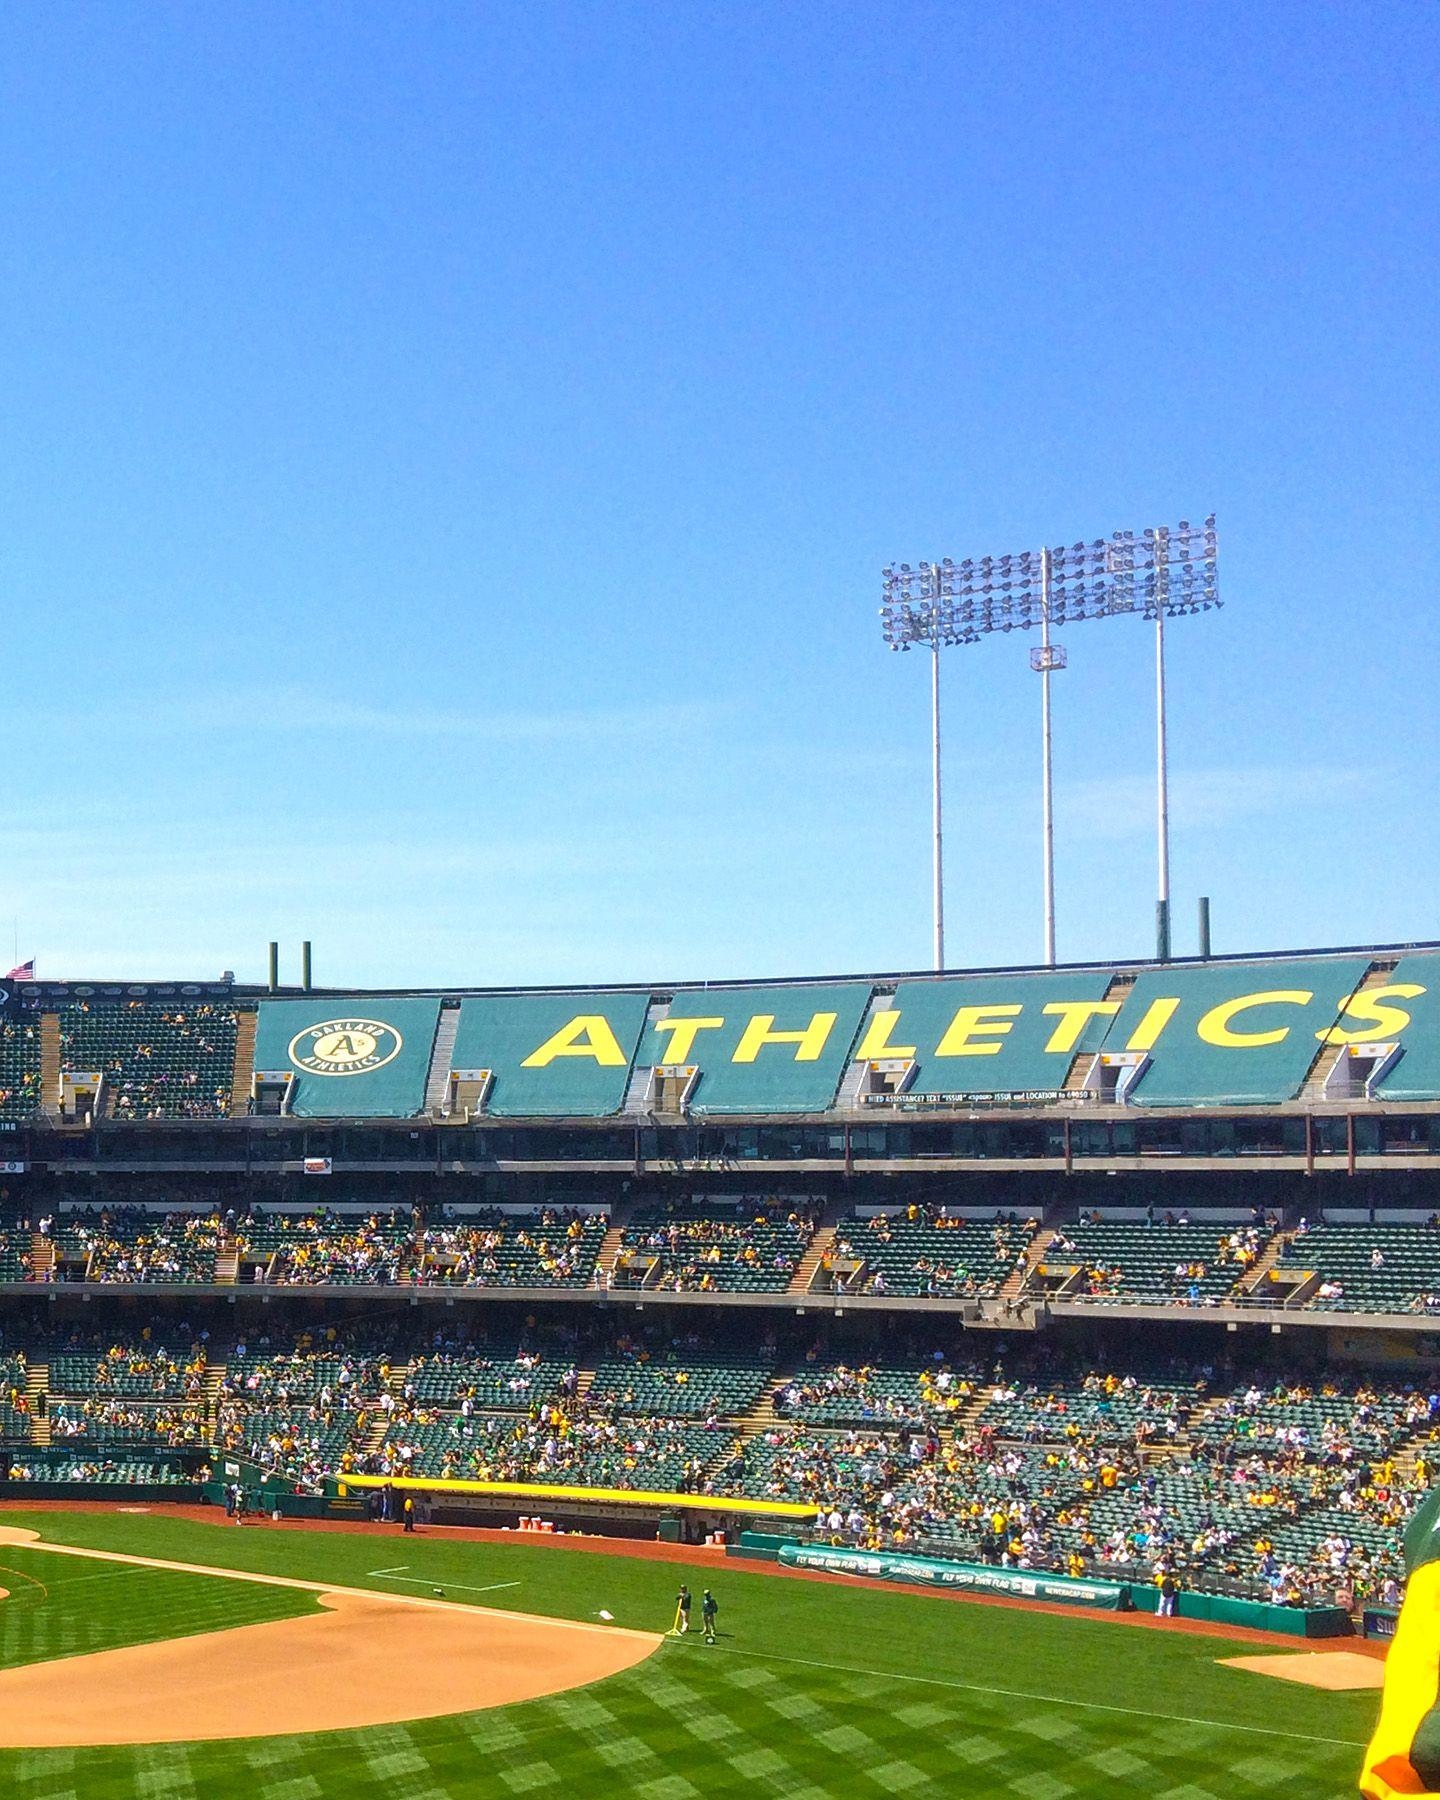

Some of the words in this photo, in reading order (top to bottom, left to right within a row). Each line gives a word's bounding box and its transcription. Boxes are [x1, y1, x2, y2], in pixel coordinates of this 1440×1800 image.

[310, 1022, 385, 1038] OAKLAND
[518, 983, 1428, 1068] ATHLETICS
[325, 1034, 366, 1056] A's
[301, 1054, 381, 1072] ATHLETICS
[885, 1094, 925, 1103] ASSISTANCE?
[926, 1094, 940, 1102] TEXT
[994, 1092, 1012, 1101] ISSUE
[1013, 1092, 1025, 1100] and
[1026, 1091, 1057, 1100] LOCATION
[1058, 1091, 1066, 1099] to
[796, 1555, 808, 1564] FLY
[808, 1556, 825, 1566] YOUR
[841, 1560, 857, 1570] FLAG
[942, 1572, 955, 1582] FLY
[974, 1575, 992, 1586] OWN
[992, 1578, 1010, 1589] FLAG
